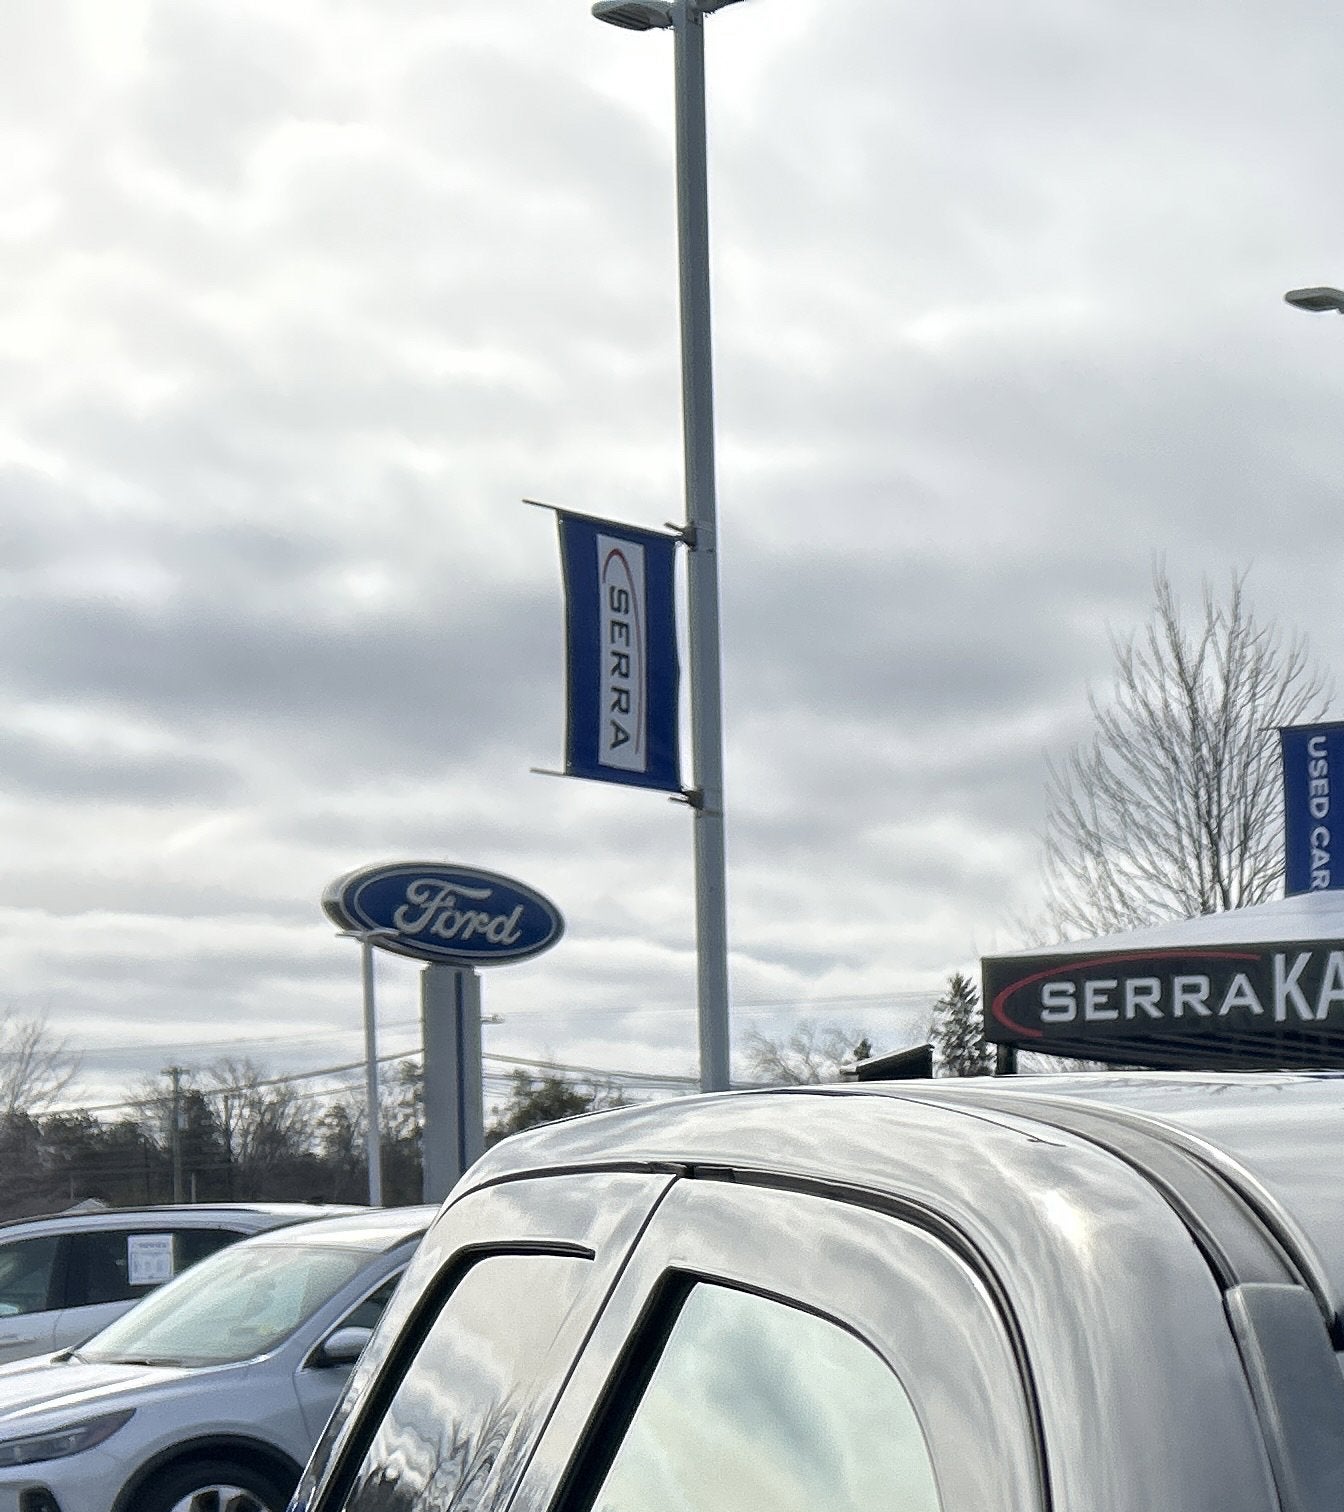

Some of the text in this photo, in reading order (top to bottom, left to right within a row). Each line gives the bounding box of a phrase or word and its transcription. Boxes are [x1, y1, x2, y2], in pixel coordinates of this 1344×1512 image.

[608, 586, 631, 750] SERRA
[1307, 735, 1331, 891] USED CAR
[393, 878, 524, 945] Ford
[1039, 972, 1265, 1024] SERRA
